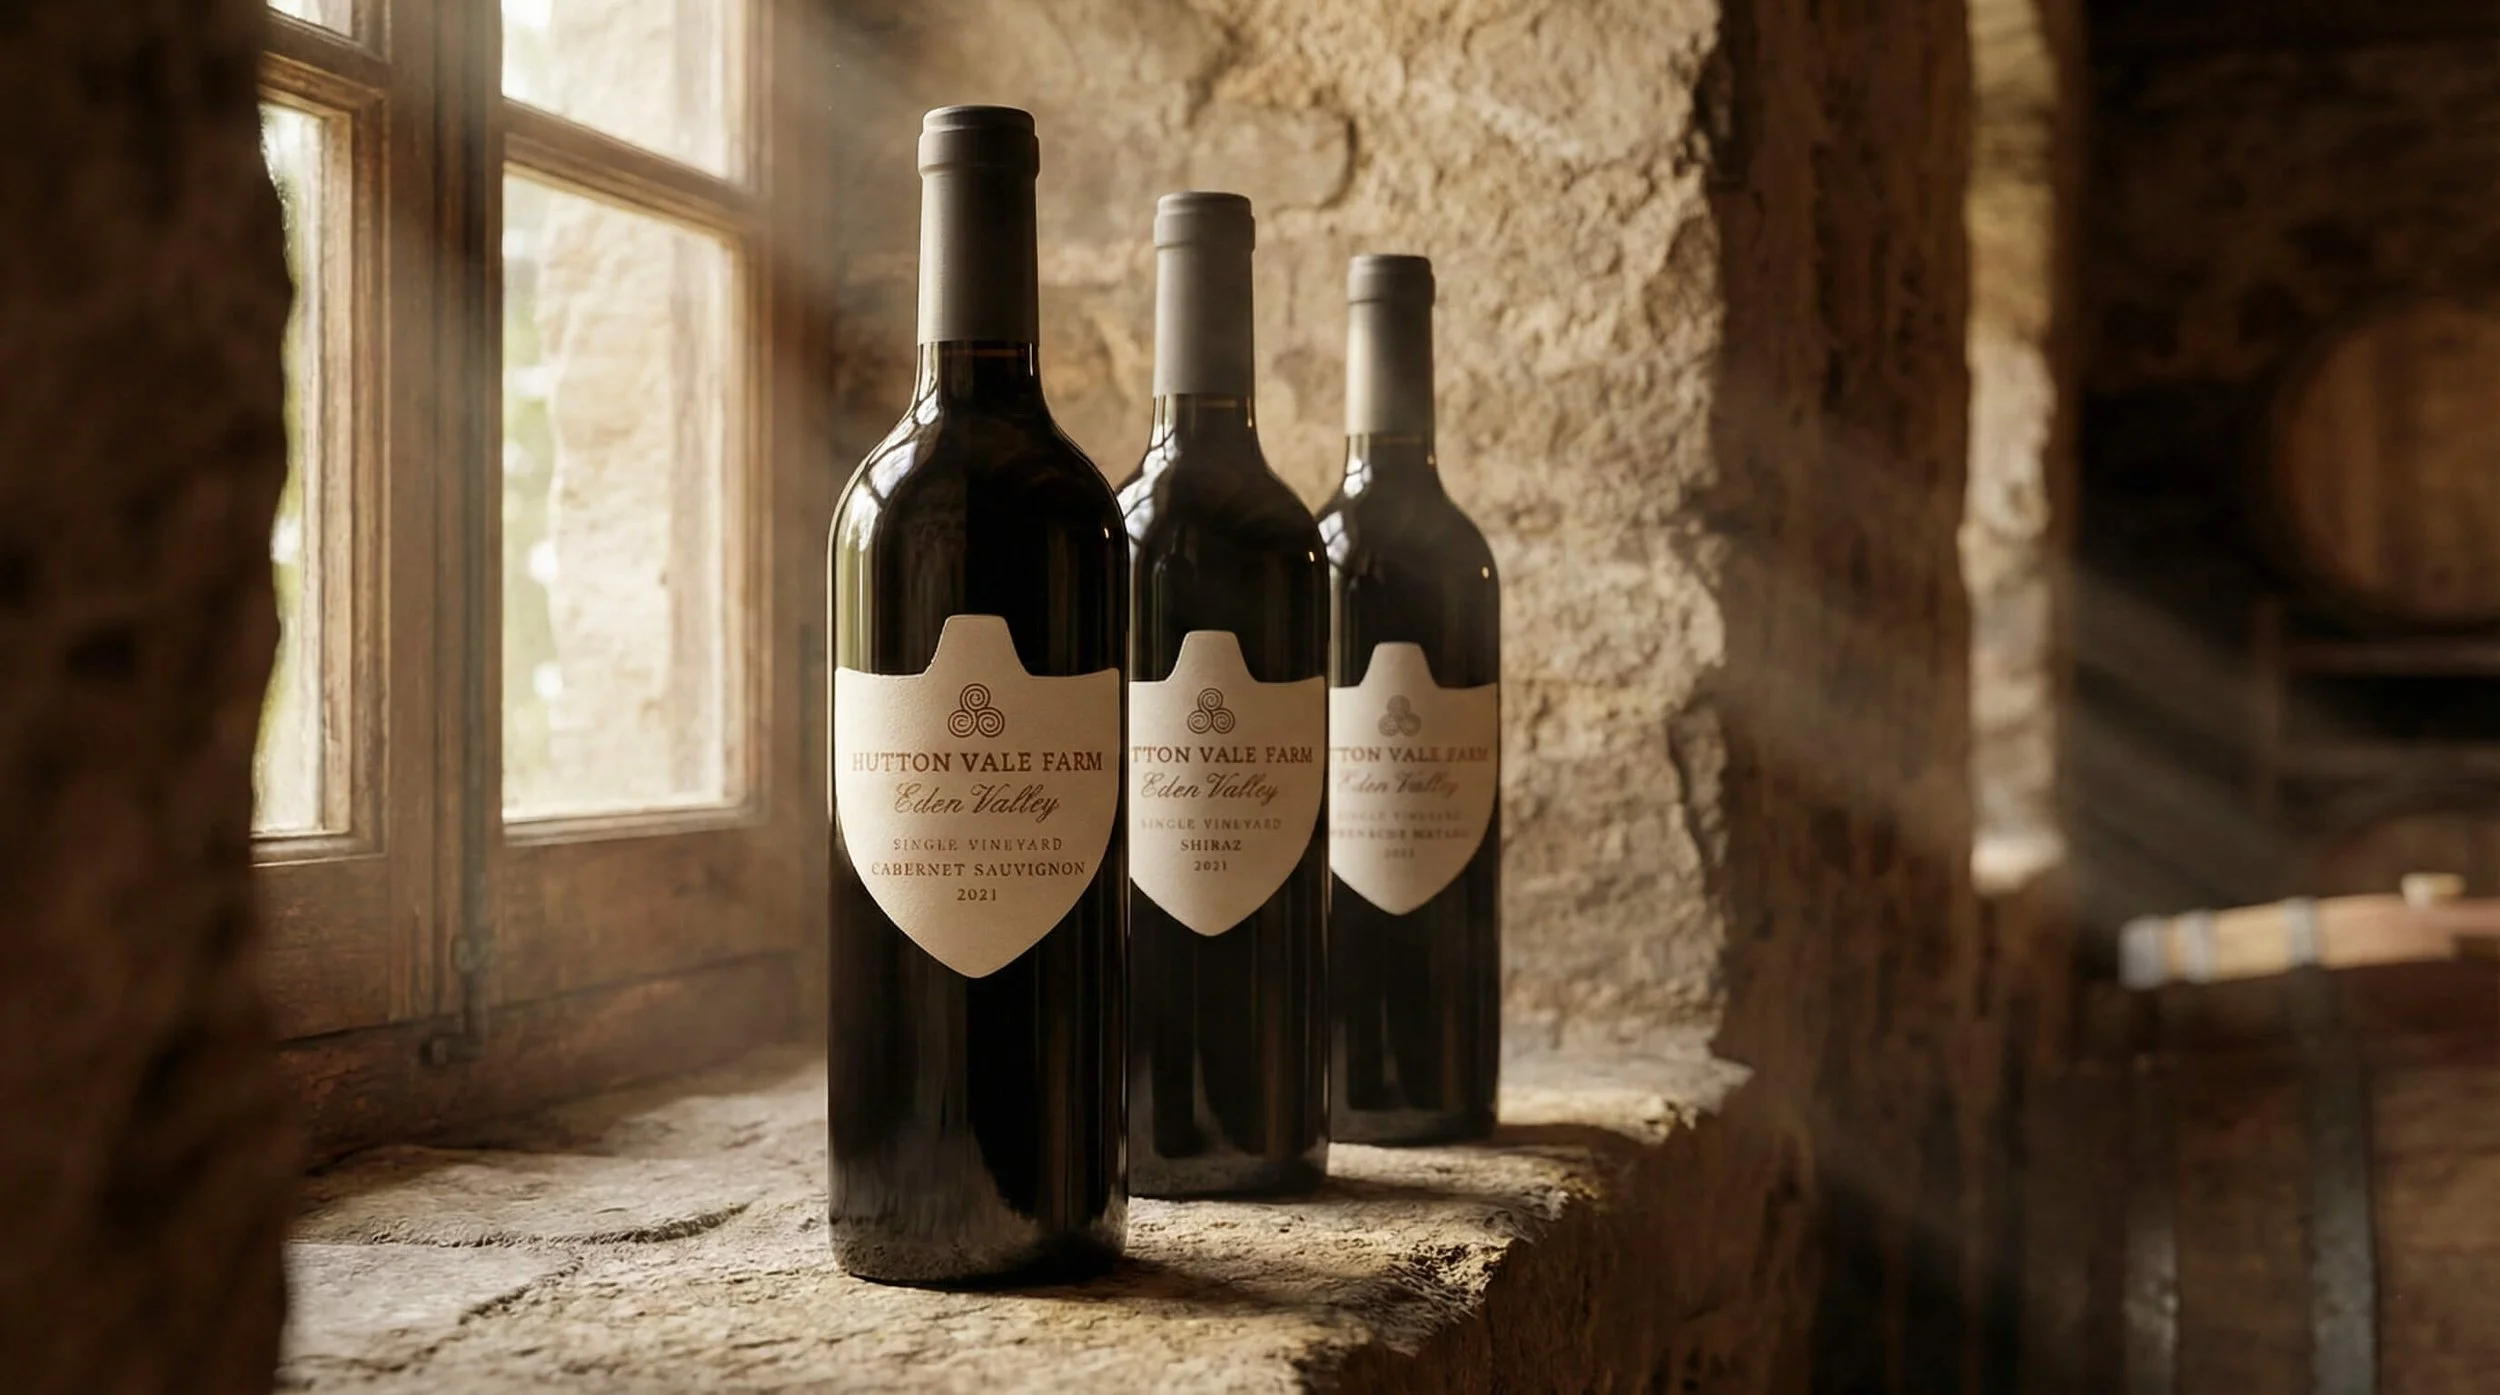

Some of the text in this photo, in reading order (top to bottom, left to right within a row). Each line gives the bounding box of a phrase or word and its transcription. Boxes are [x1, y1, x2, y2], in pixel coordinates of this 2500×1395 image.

[1200, 746, 1256, 763] VALE
[1265, 746, 1313, 763] FARM
[852, 752, 1103, 772] HUTTON VALE FARM
[1141, 772, 1279, 806] Eden Valley
[894, 783, 1060, 823] Eden Valley
[1203, 818, 1282, 830] VINEYARD
[893, 838, 1062, 851] SINGLE VINEYARD
[1180, 839, 1243, 851] SHIRAZ
[871, 861, 1085, 877] CABERNET SAUVIGNON
[1194, 860, 1227, 871] 2021
[956, 888, 997, 901] 2021
